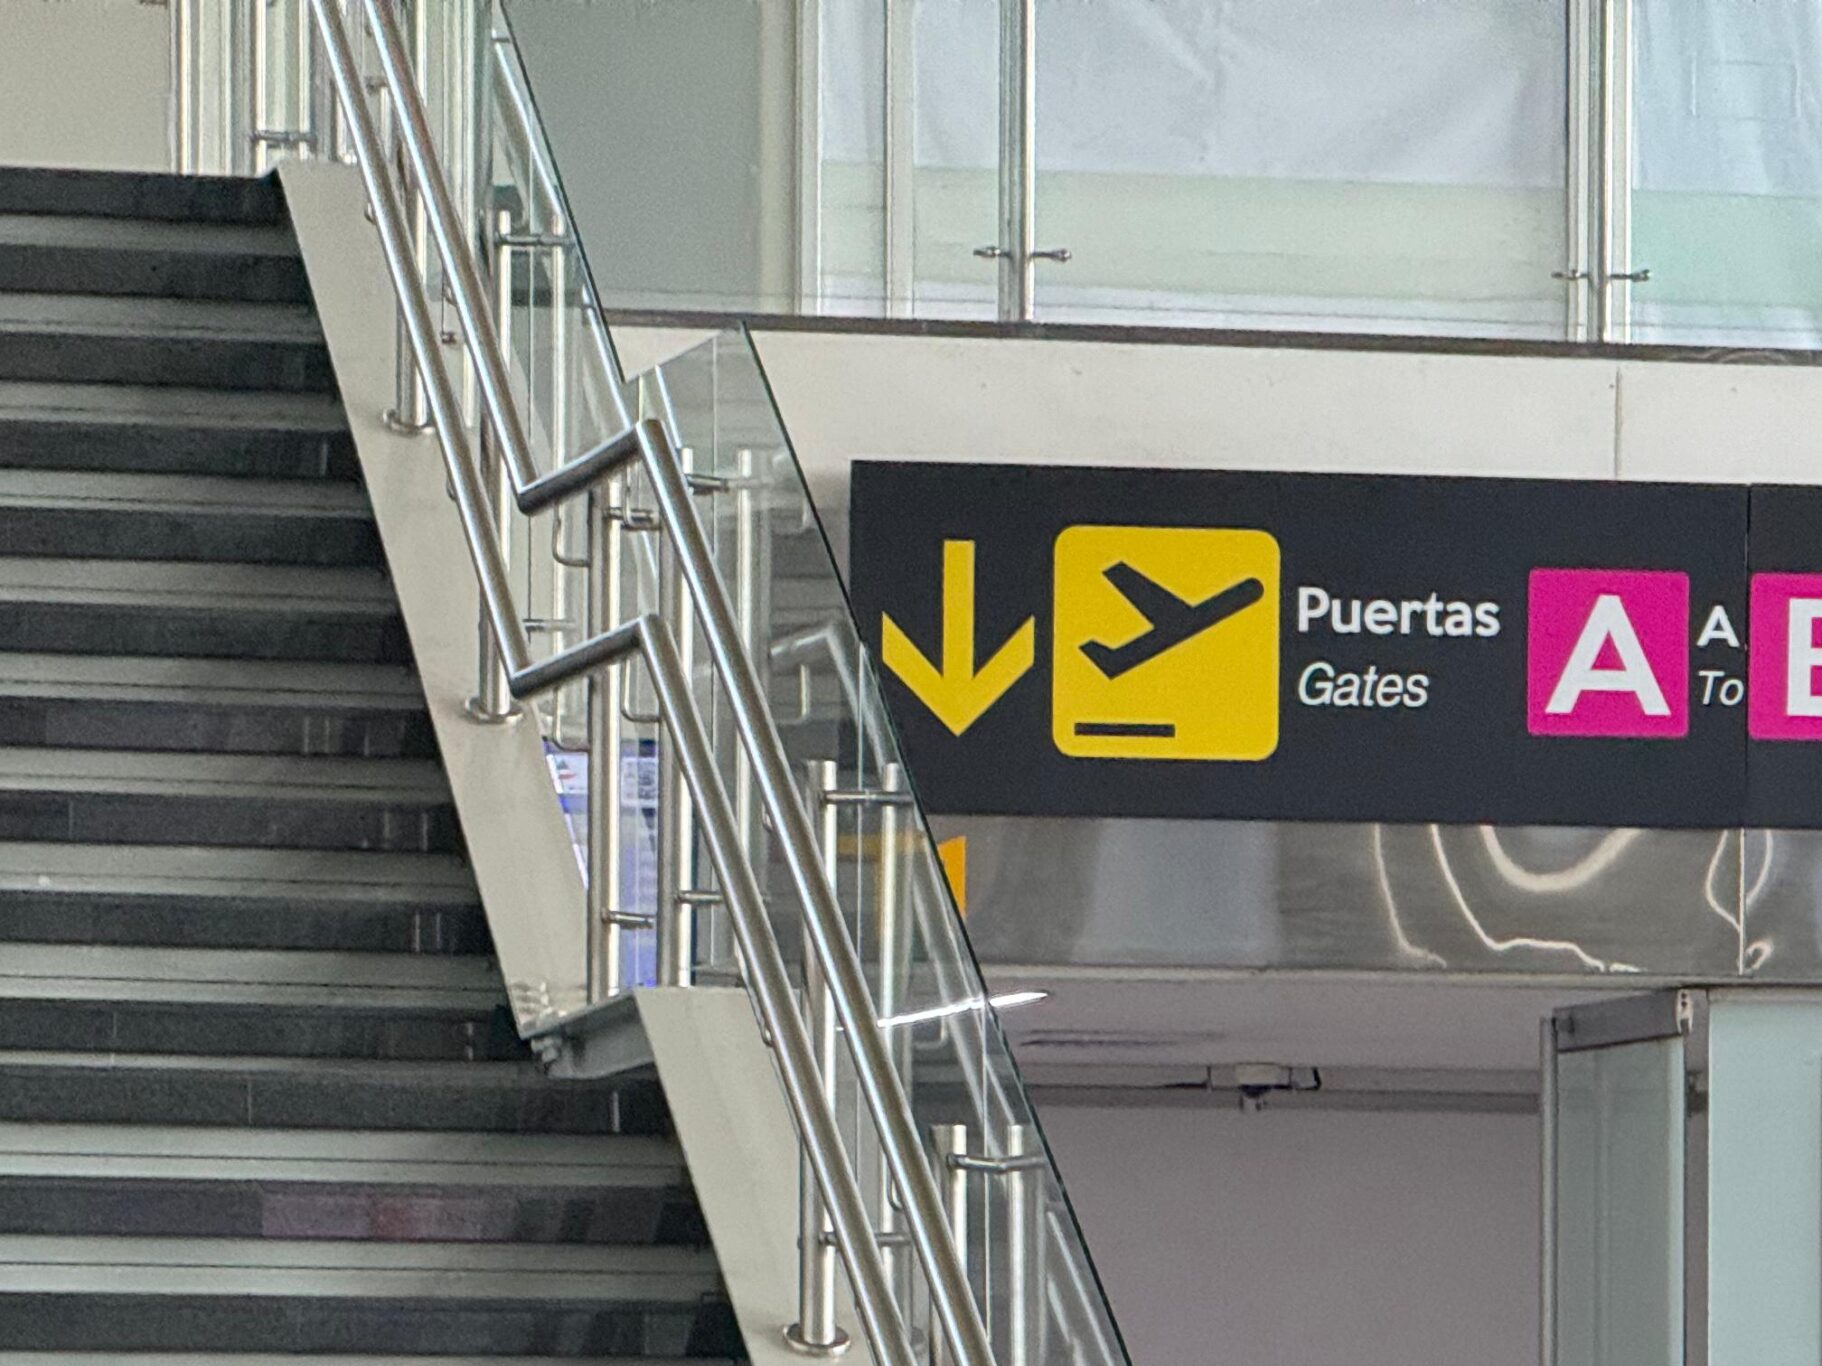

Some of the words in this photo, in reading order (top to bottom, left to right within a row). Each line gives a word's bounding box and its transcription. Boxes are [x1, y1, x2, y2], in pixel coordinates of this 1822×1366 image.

[1298, 586, 1501, 637] Puertas
[1696, 605, 1740, 647] A
[1545, 594, 1671, 716] A
[1297, 662, 1430, 708] Gates
[1697, 670, 1744, 706] To
